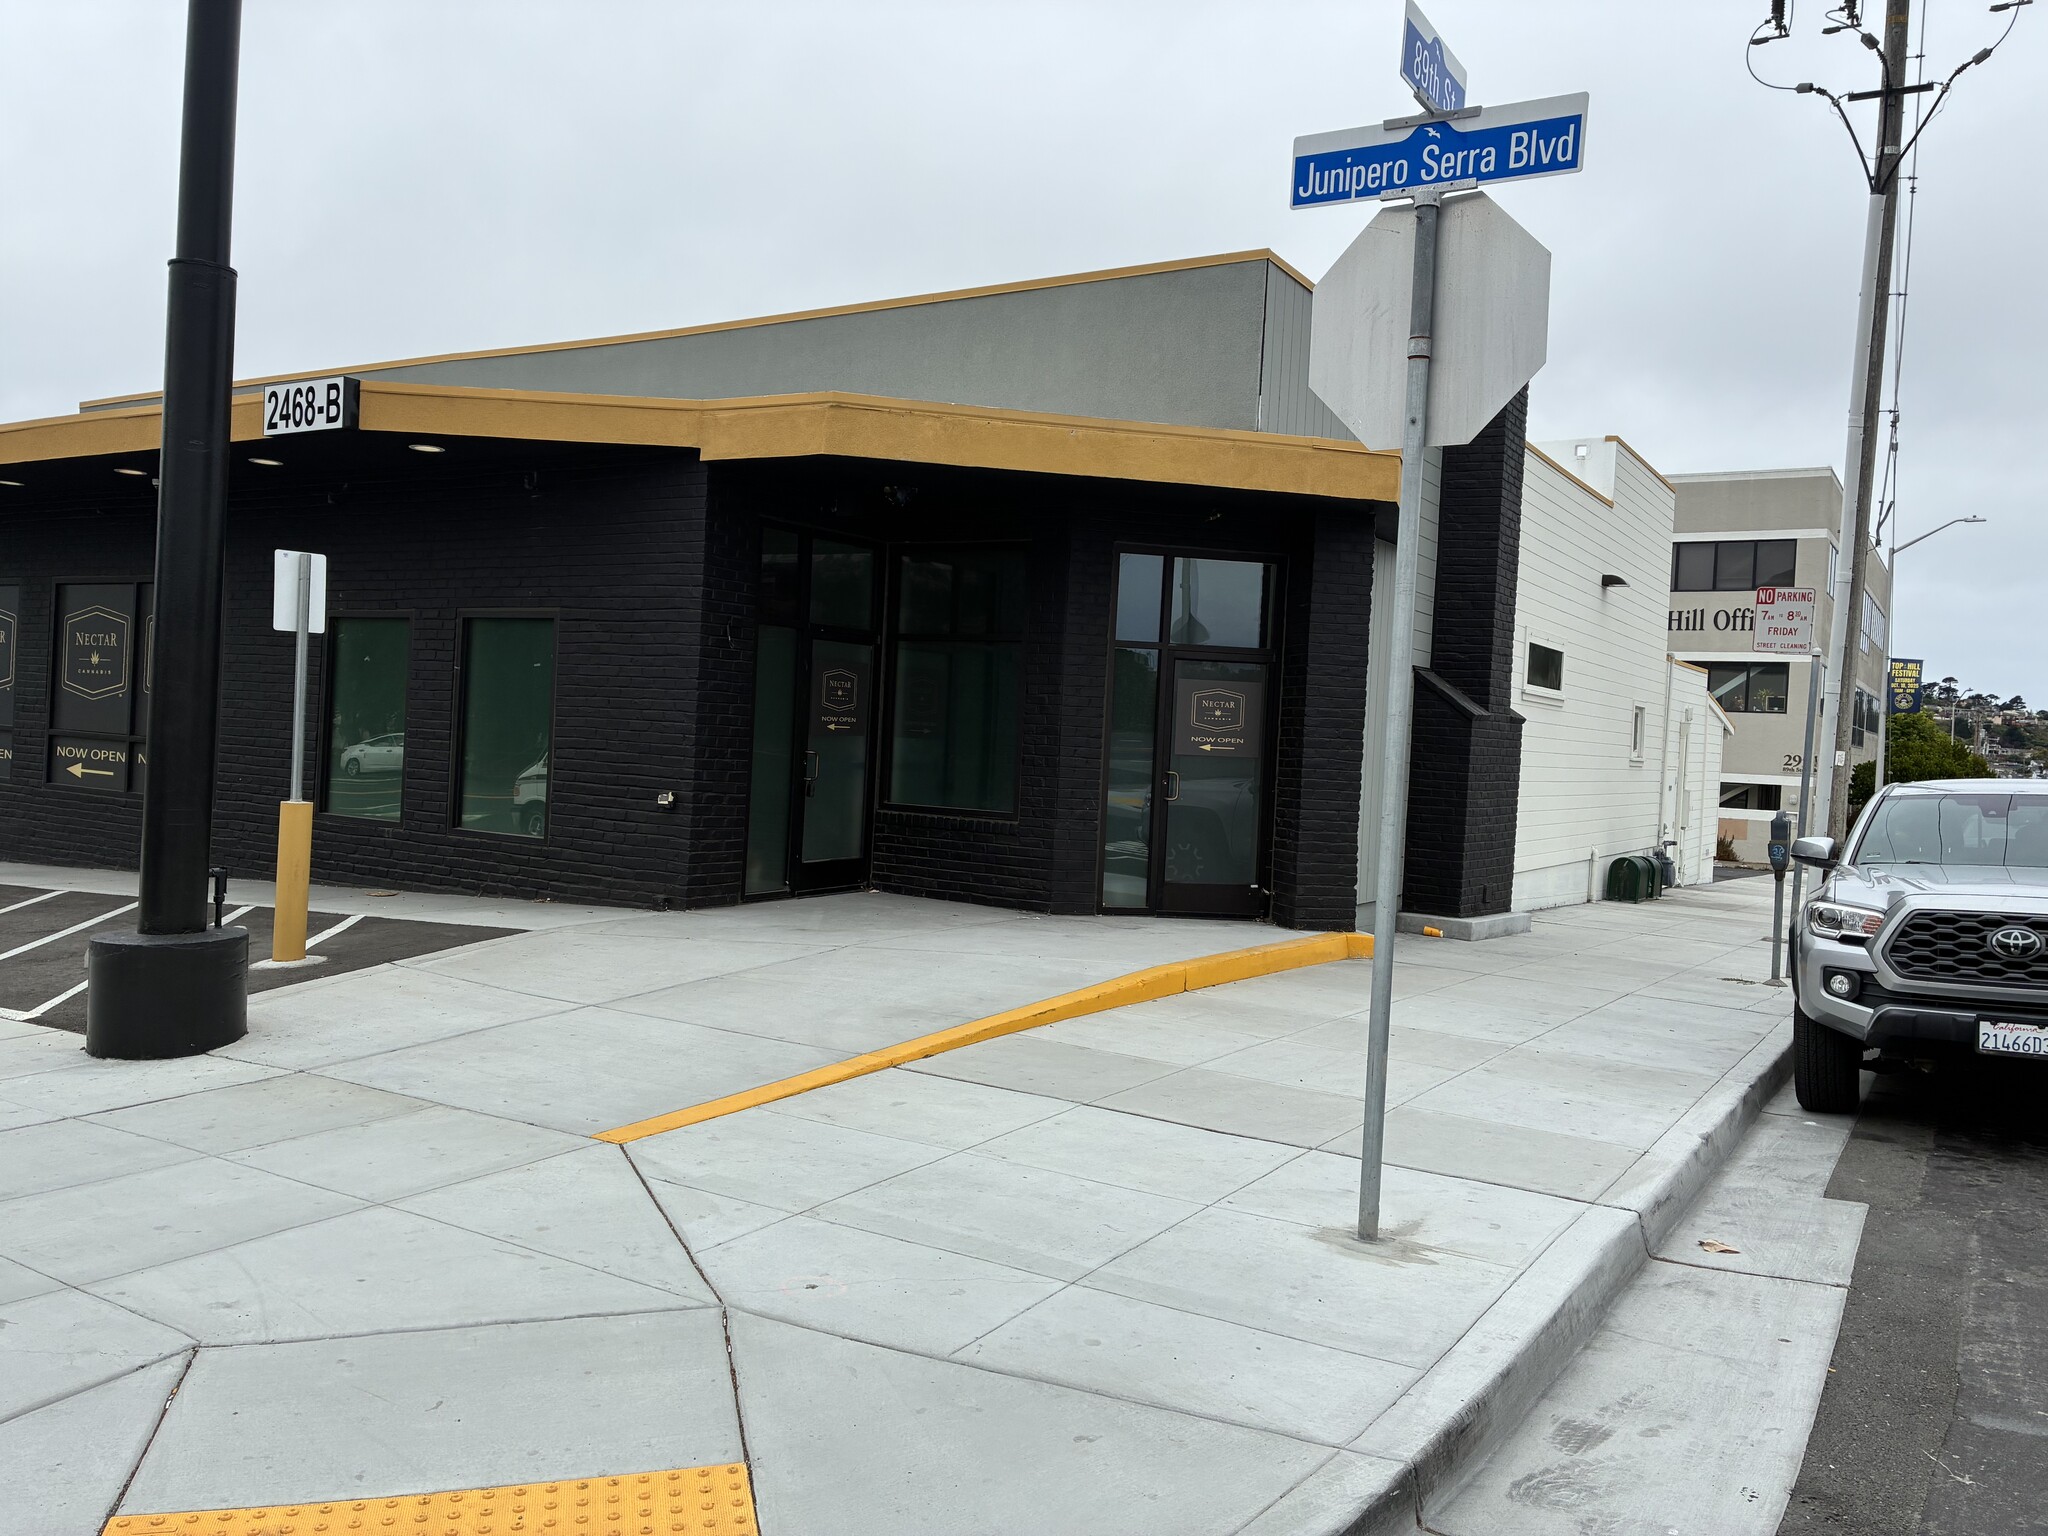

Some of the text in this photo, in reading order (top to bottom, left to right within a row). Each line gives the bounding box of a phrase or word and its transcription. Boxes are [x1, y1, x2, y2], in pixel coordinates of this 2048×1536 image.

[1414, 40, 1456, 111] 89th St
[1299, 123, 1575, 199] Junipero Serra Blvd
[266, 382, 341, 430] 2468-B
[1758, 589, 1813, 604] NO PARKING
[1668, 608, 1705, 631] Hill
[1767, 626, 1799, 636] FRIDAY
[75, 632, 118, 647] NECTAR
[1779, 642, 1808, 650] CLEANING
[1891, 662, 1904, 670] TOP
[1907, 662, 1921, 671] HILL
[1891, 669, 1920, 678] FESTIVAL
[1202, 700, 1236, 709] NECTAR
[56, 746, 88, 759] NOW
[90, 749, 126, 763] OPEN
[1993, 1022, 2039, 1034] California
